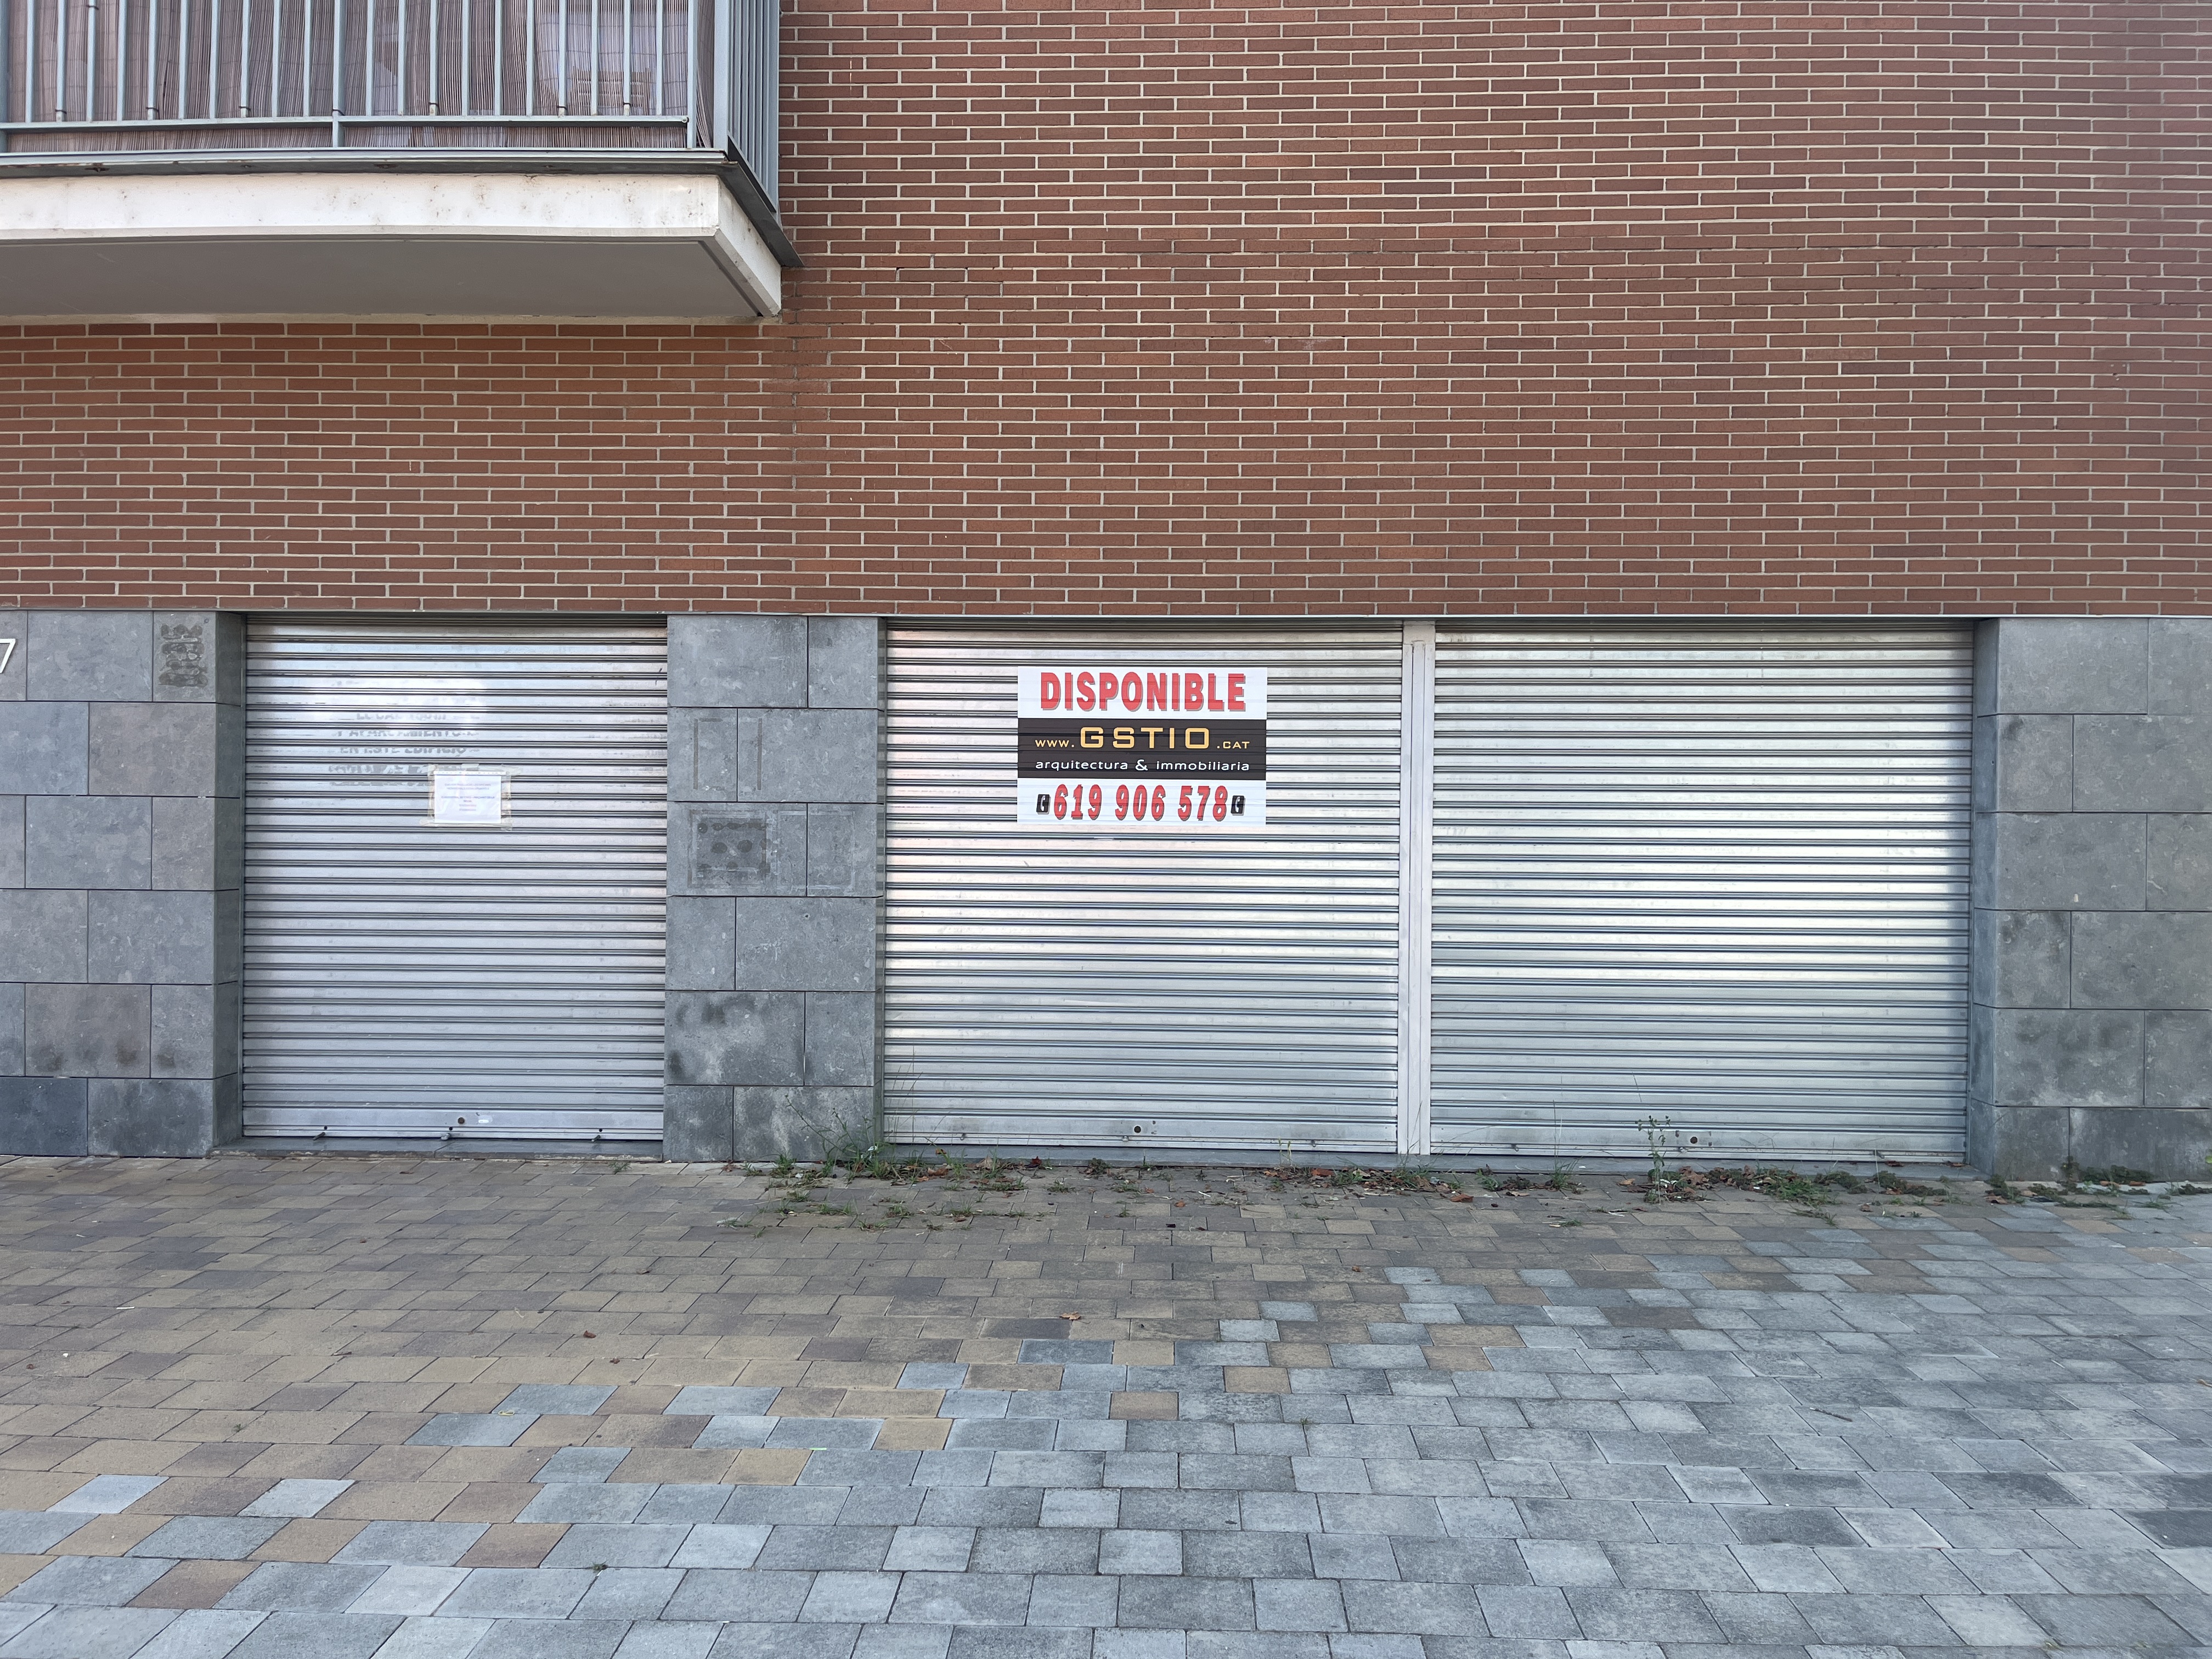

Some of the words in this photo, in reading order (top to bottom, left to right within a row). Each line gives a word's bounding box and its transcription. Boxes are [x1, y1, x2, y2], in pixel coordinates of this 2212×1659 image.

[0, 639, 16, 673] 7
[1041, 672, 1246, 712] DISPONIBLE
[1035, 760, 1128, 771] arquitectura
[1135, 759, 1149, 771] &
[1156, 760, 1250, 771] immobiliaria
[1054, 784, 1102, 821] 619
[1115, 784, 1166, 821] 906
[1177, 785, 1228, 822] 578
